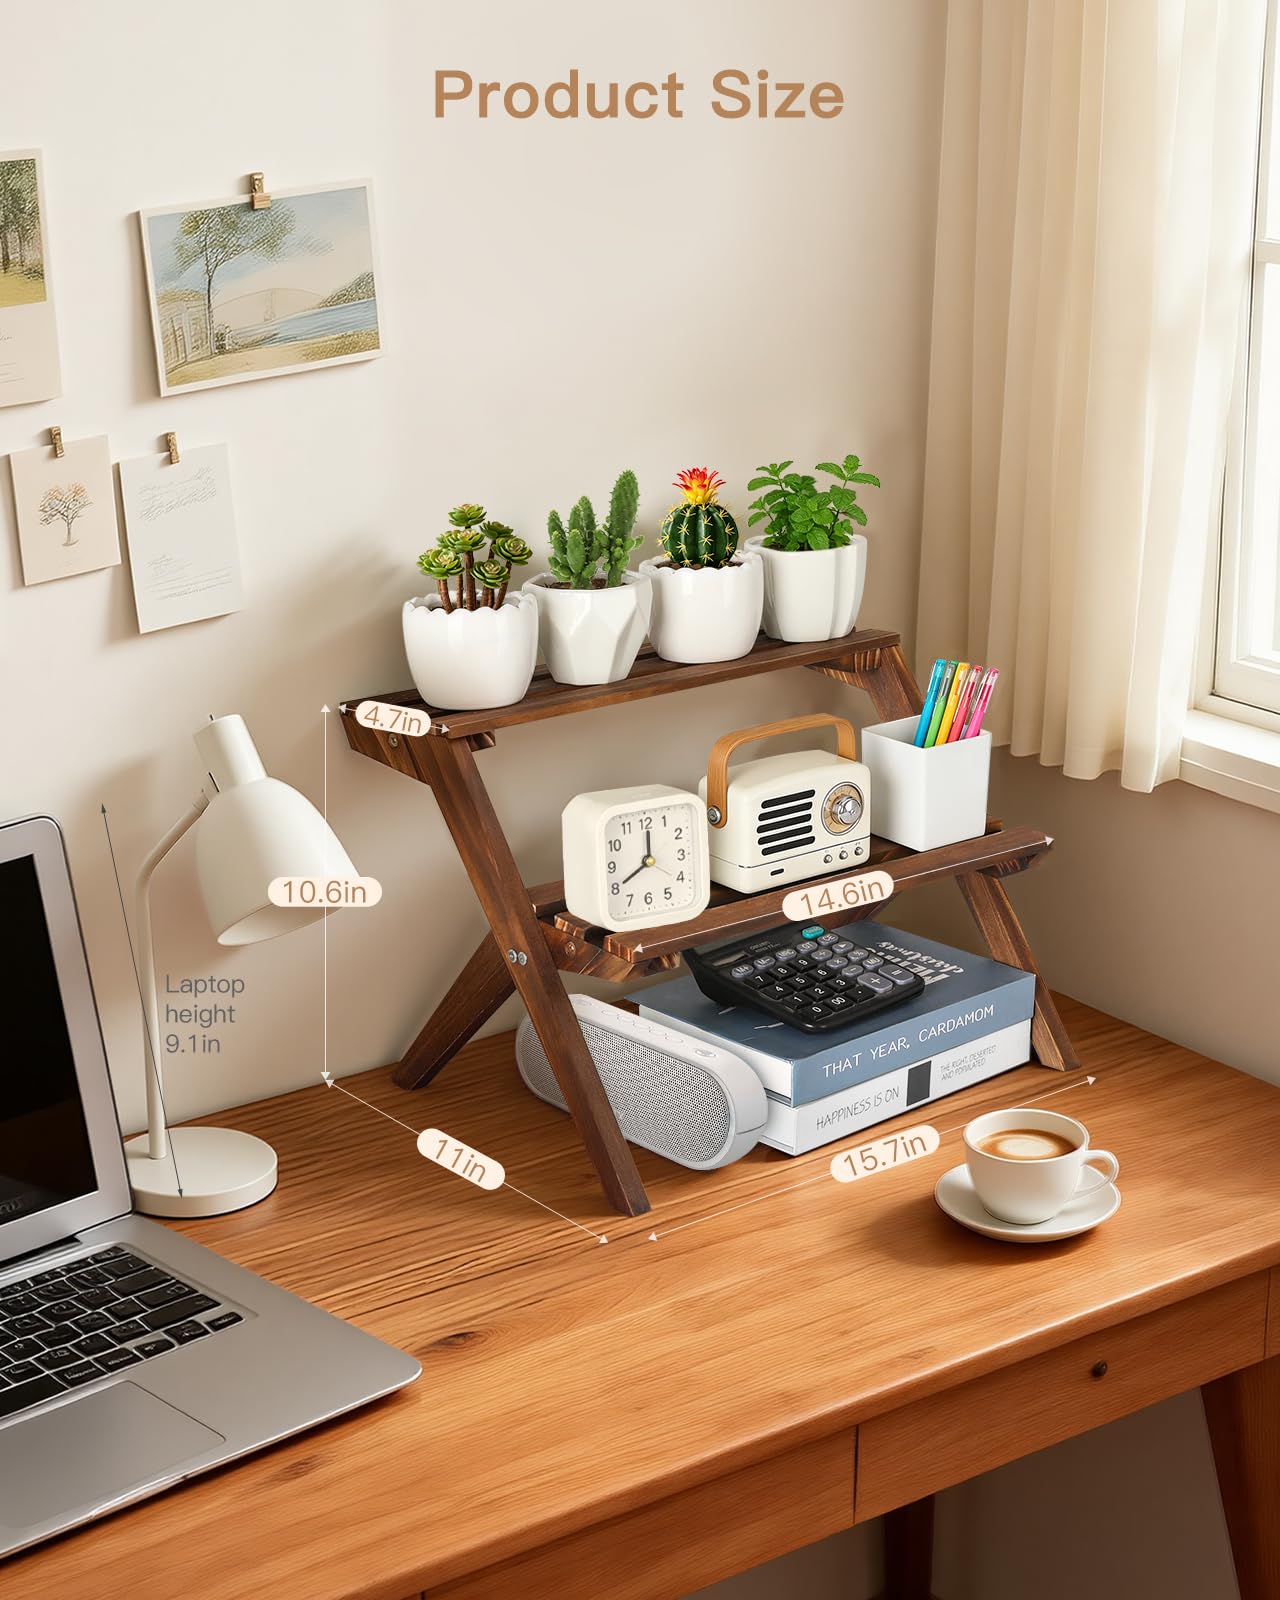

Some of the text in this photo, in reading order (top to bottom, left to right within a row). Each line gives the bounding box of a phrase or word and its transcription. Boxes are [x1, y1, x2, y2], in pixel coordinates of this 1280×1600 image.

[639, 816, 653, 831] 12
[661, 814, 667, 828] 1
[621, 821, 632, 836] 11
[674, 827, 683, 840] 2
[608, 838, 622, 852] 10
[677, 848, 686, 861] 3
[607, 861, 617, 874] 9
[676, 870, 685, 883] 4
[611, 882, 620, 895] 8
[663, 887, 673, 900] 5
[626, 893, 634, 907] 7
[644, 891, 653, 905] 6
[831, 996, 846, 1005] 00
[822, 1004, 995, 1078] THAT YEAR, CARDAMOM
[816, 1086, 900, 1130] HAPPINESS IS ON
